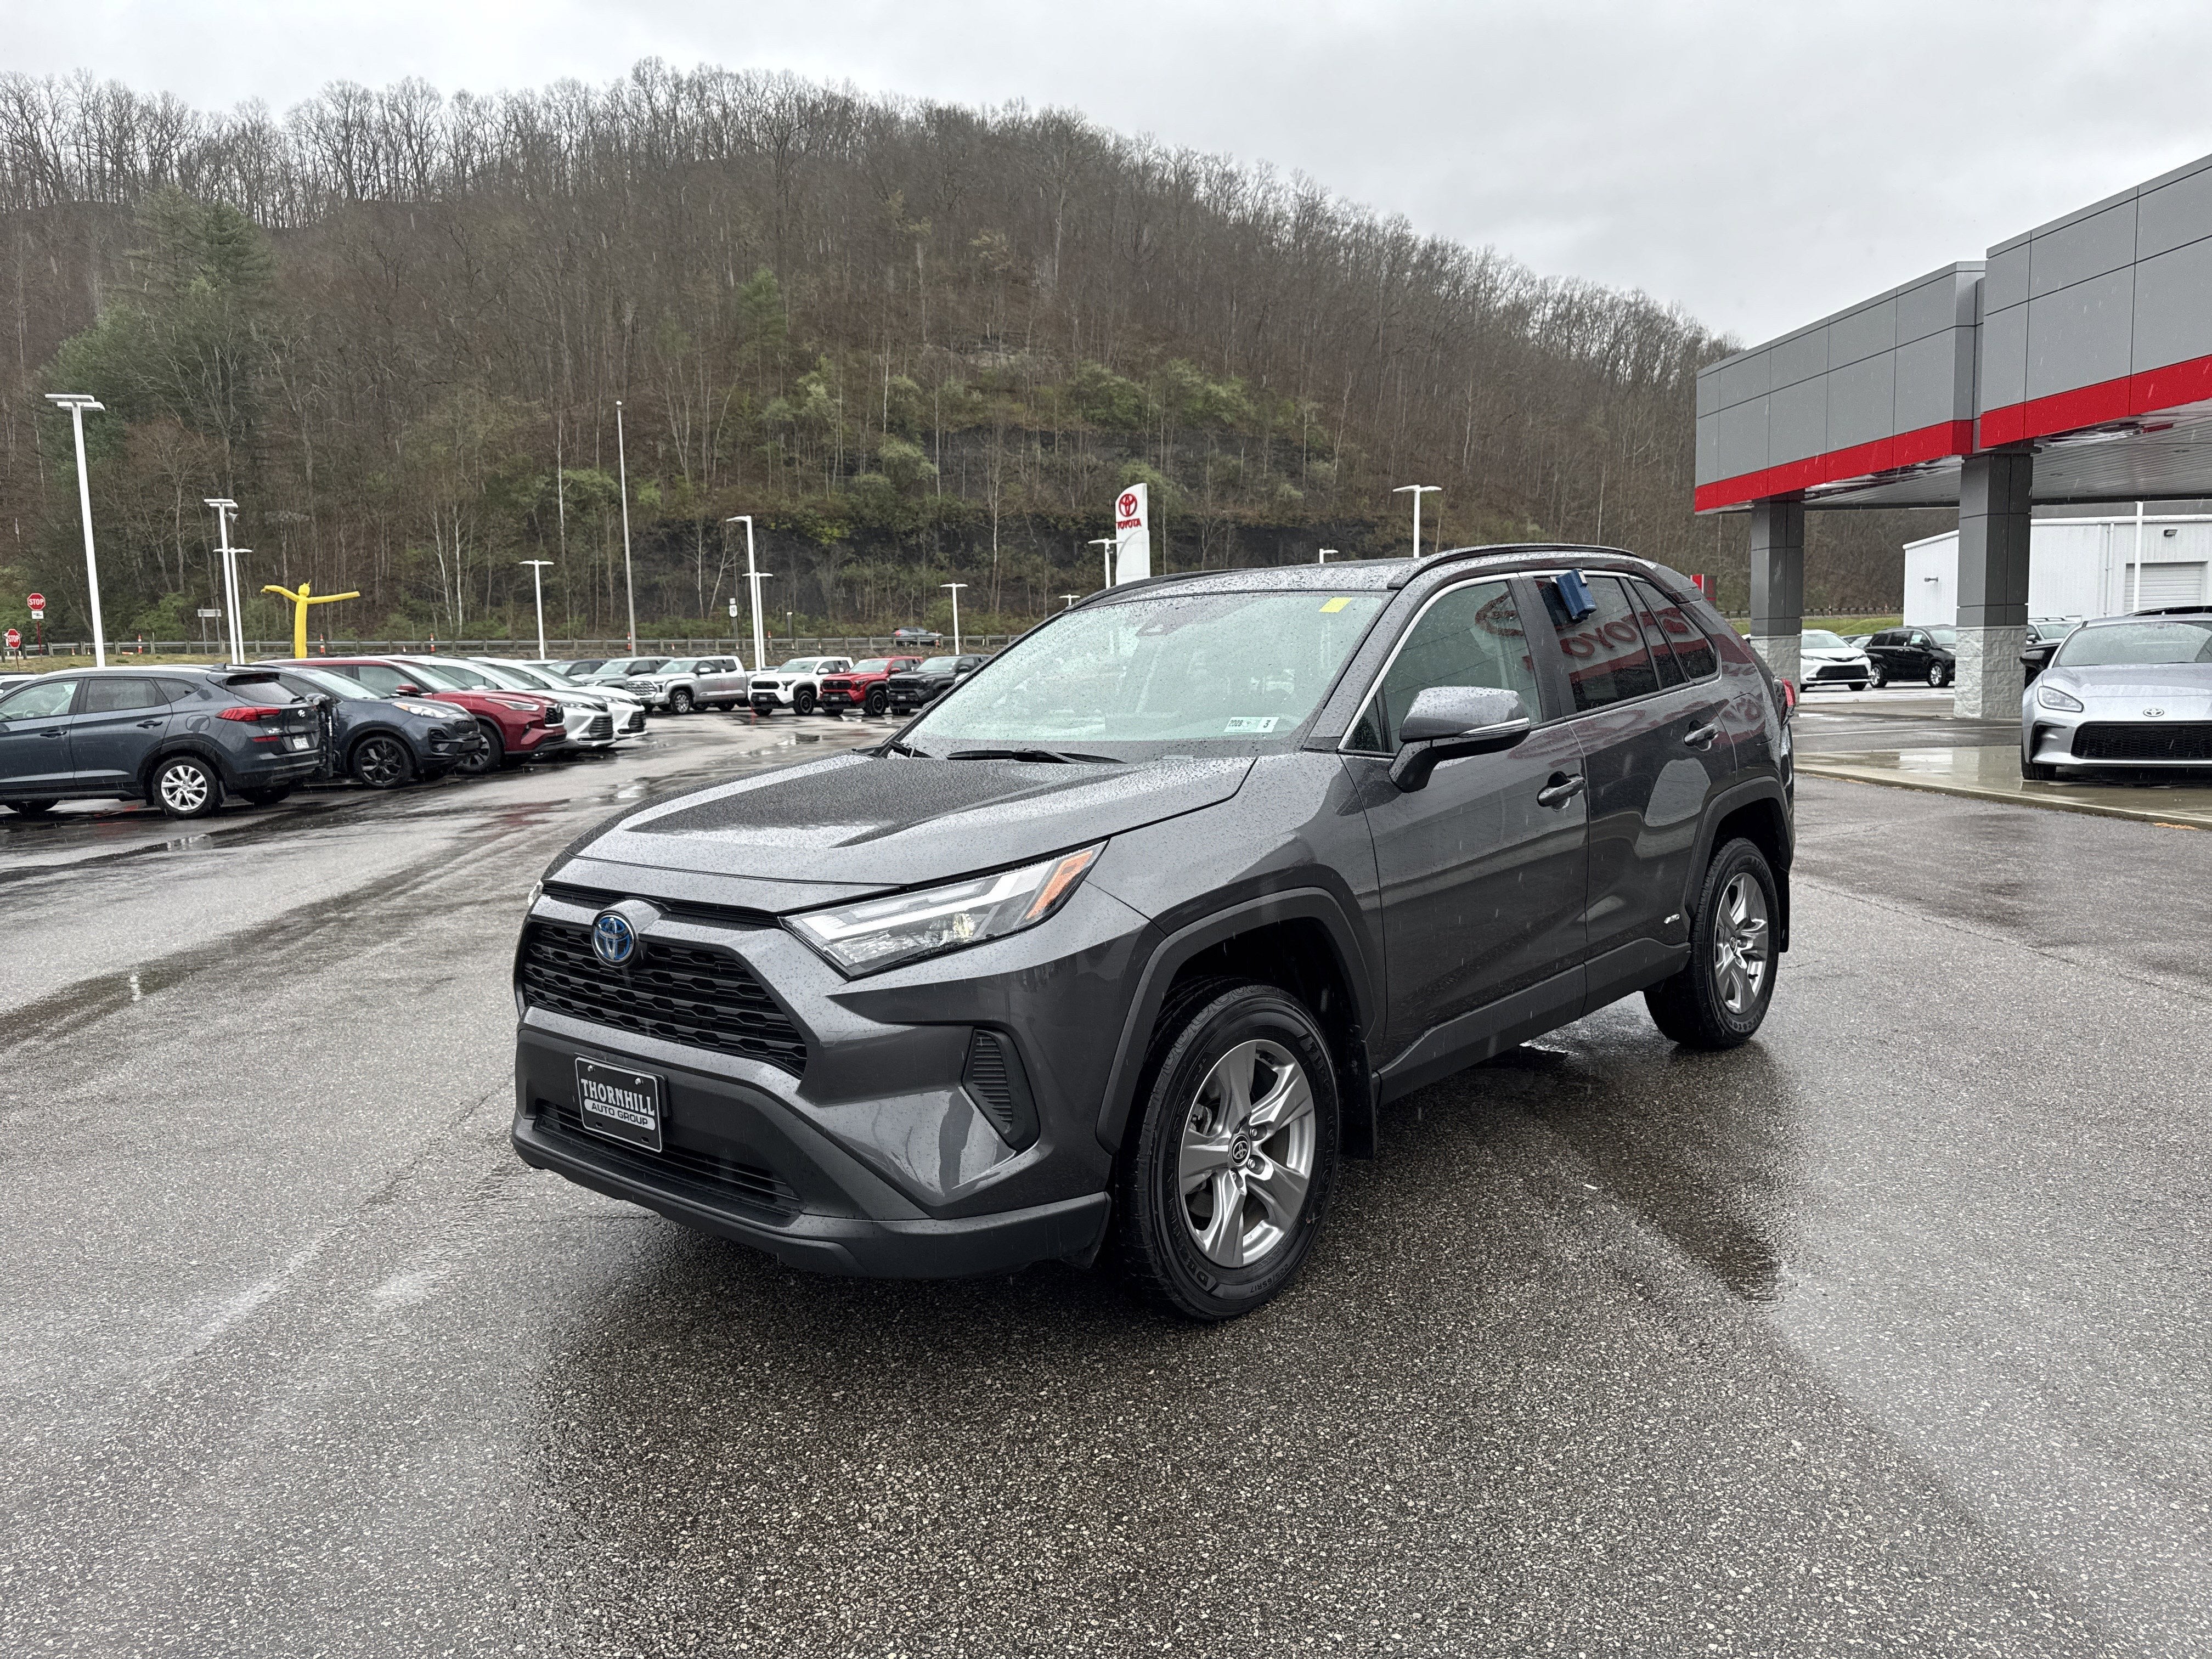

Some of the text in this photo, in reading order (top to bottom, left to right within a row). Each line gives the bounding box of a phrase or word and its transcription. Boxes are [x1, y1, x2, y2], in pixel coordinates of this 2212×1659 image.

[1116, 518, 1142, 530] TOYOTA
[1263, 720, 1271, 728] 3
[580, 1078, 655, 1116] THORNHILL
[591, 1103, 648, 1126] AUTO GROUP
[1250, 1263, 1289, 1293] 225/65R17
